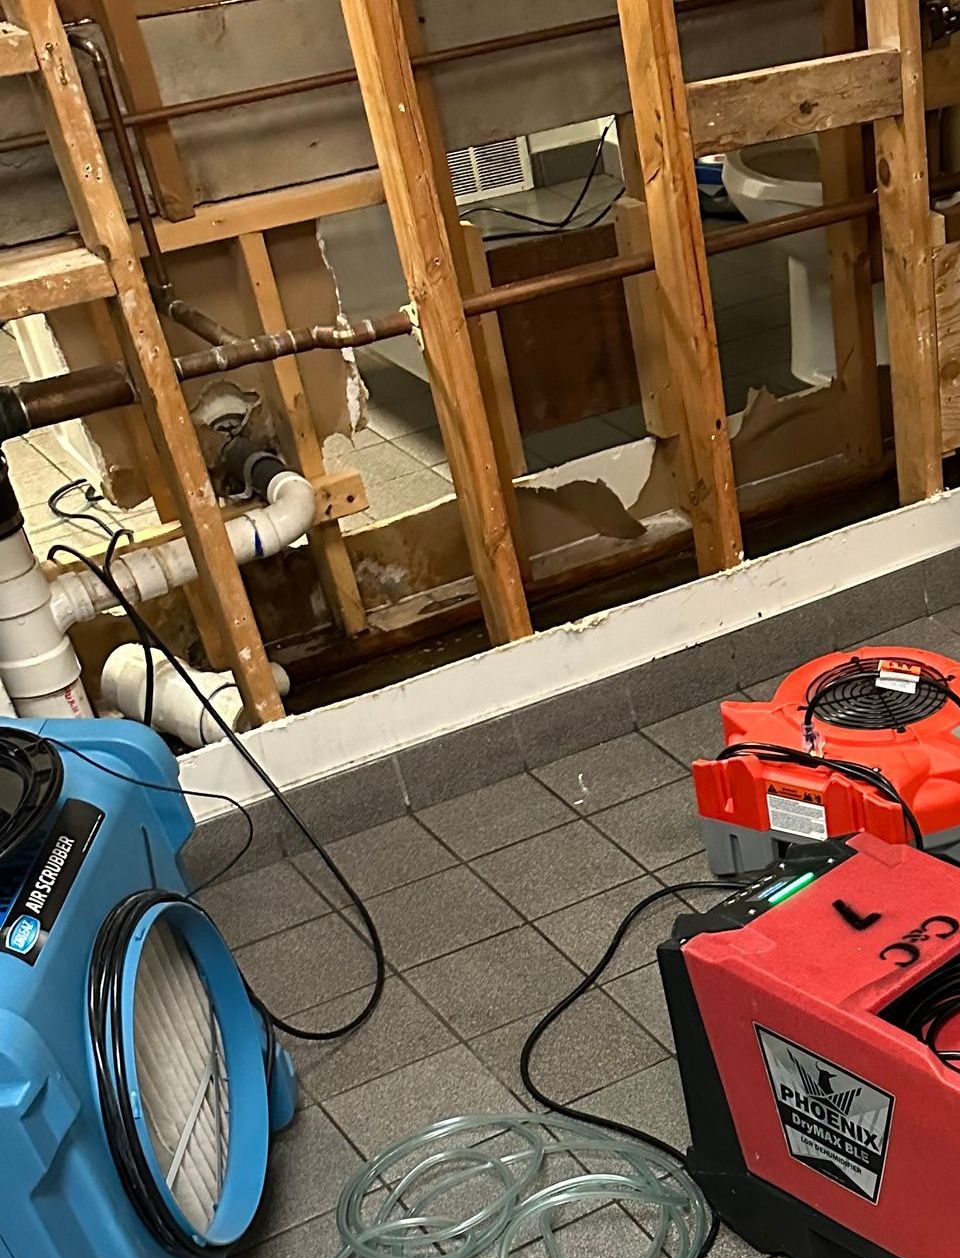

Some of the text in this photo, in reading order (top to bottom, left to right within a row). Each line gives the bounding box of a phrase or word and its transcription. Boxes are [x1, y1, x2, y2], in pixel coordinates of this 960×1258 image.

[25, 835, 75, 914] AIR SCRUBBER
[780, 1083, 881, 1153] PHOENIX
[792, 1112, 870, 1164] DryMAX BLE
[814, 1141, 862, 1175] DEHUMIDIFIER
